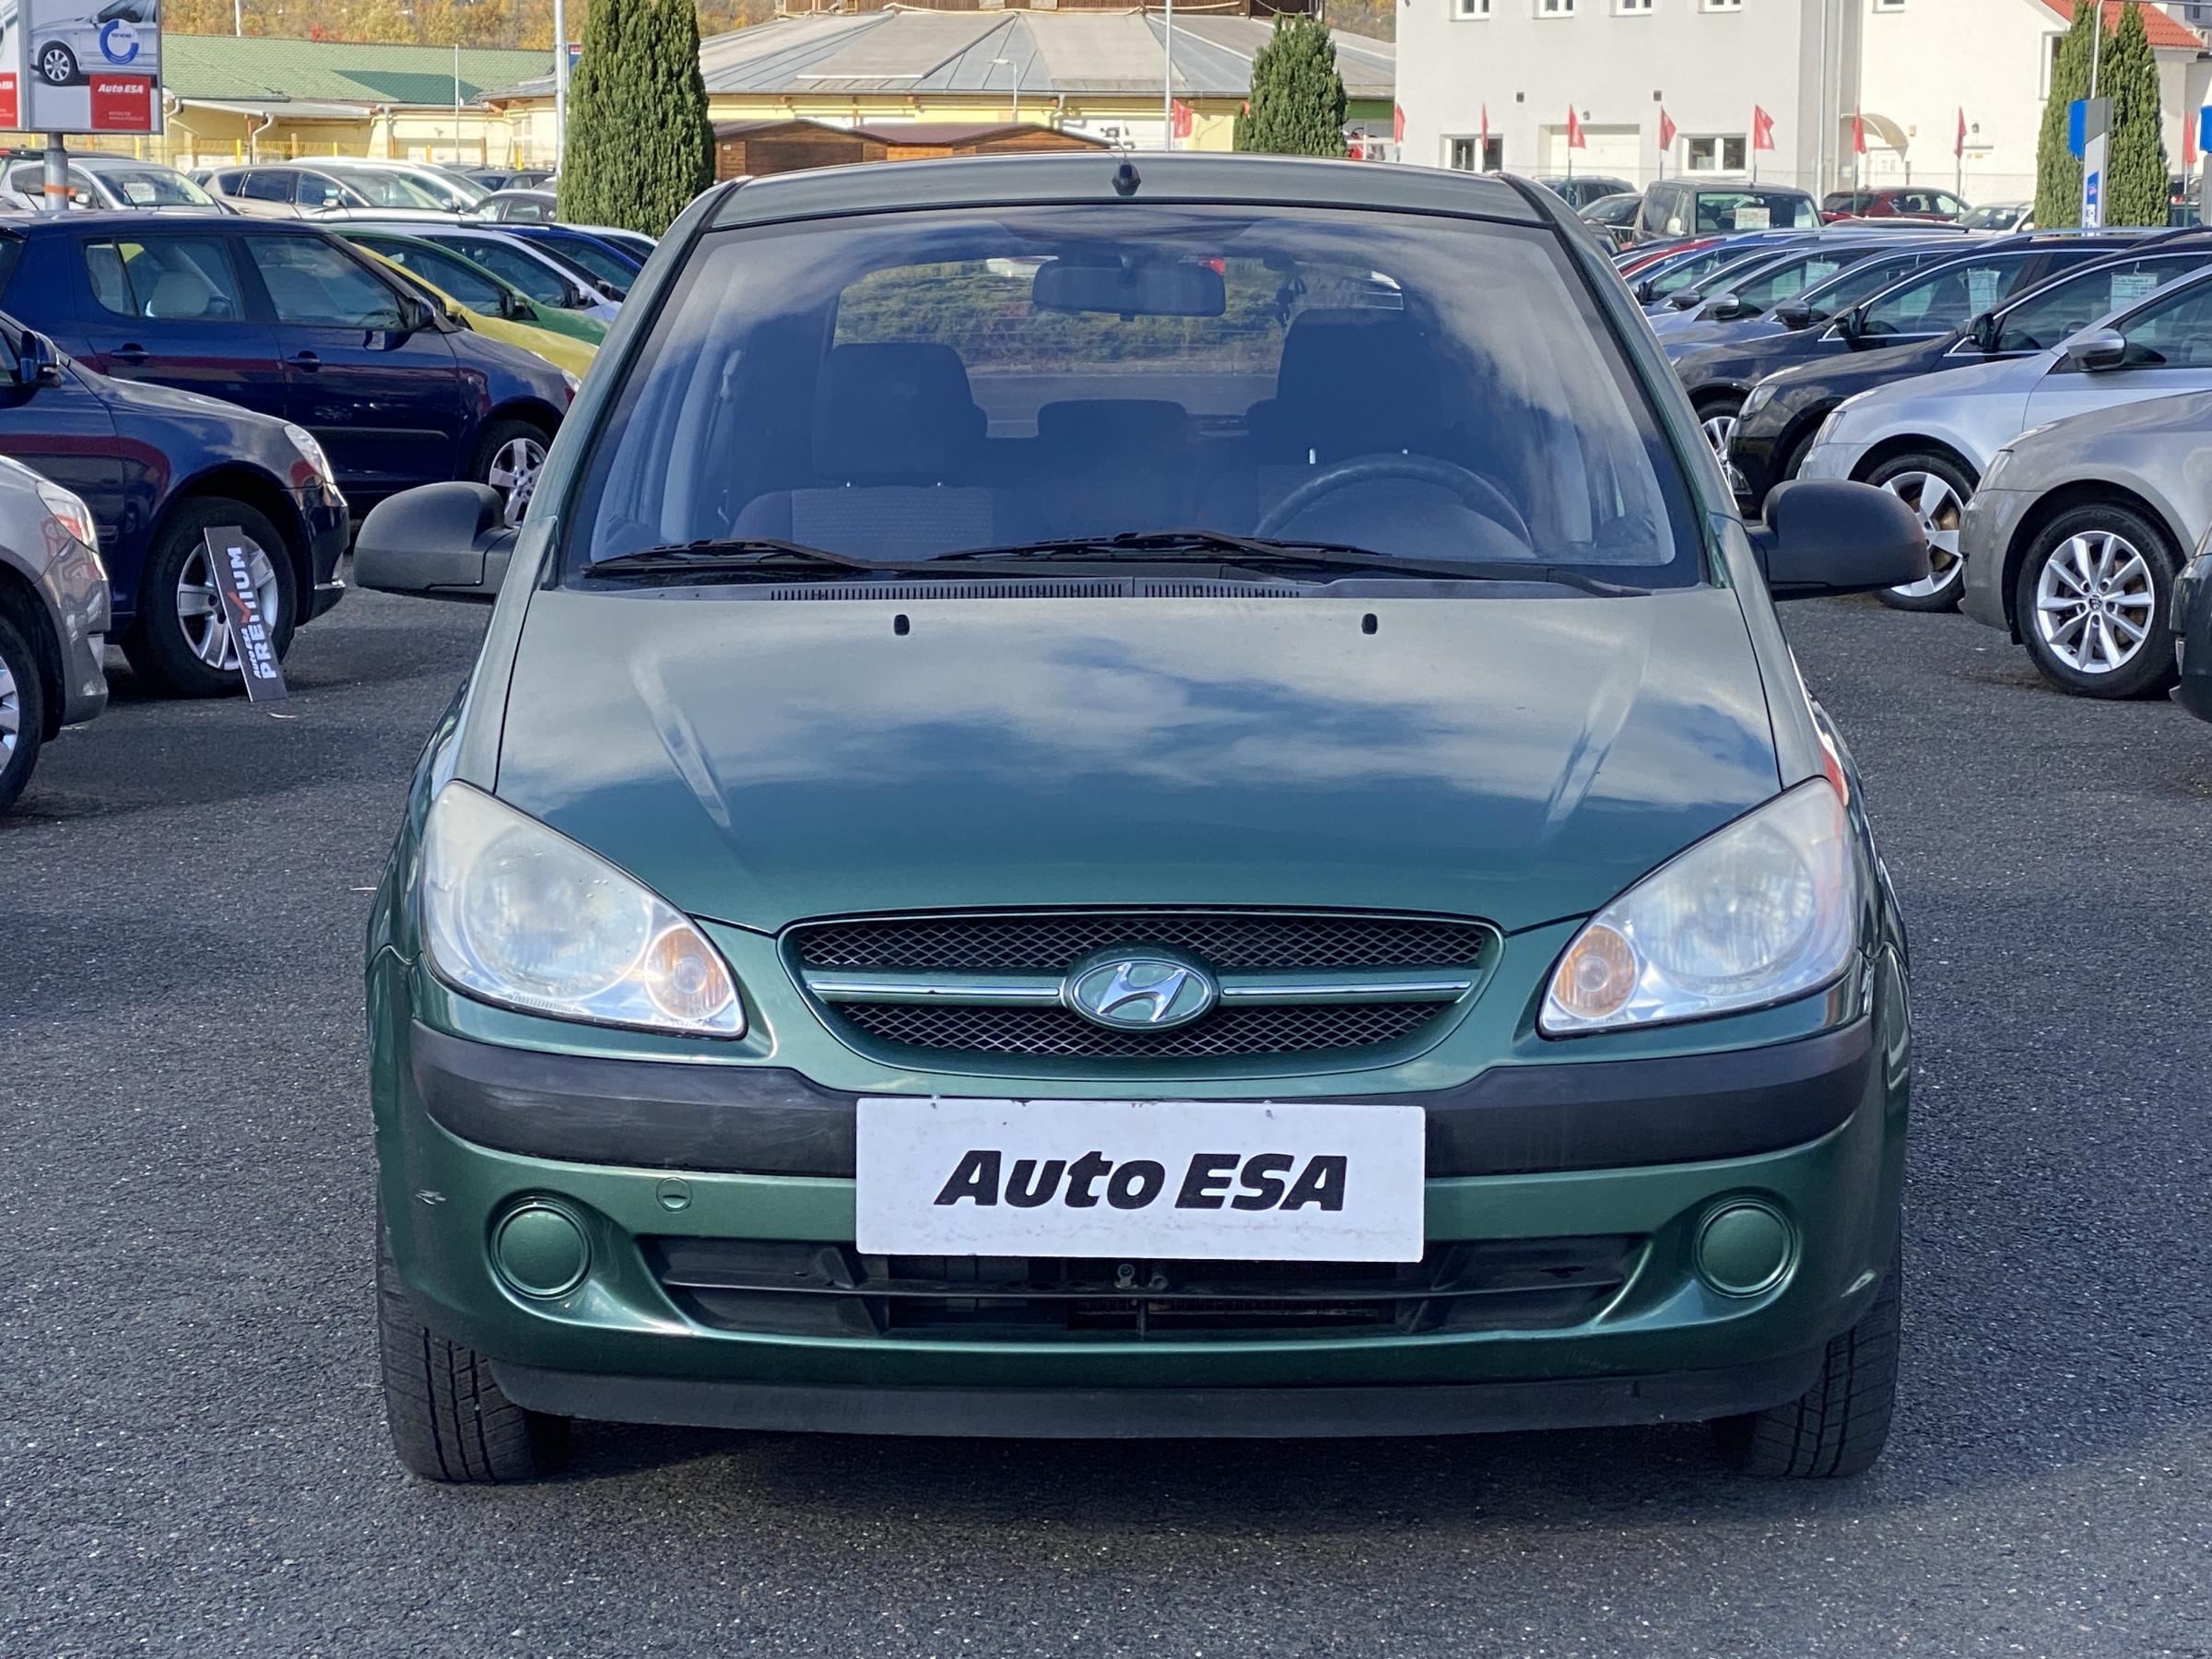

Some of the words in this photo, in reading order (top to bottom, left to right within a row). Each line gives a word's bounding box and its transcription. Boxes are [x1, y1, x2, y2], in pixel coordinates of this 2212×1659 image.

[98, 84, 124, 93] Auto
[123, 85, 144, 93] ESA
[933, 1150, 1166, 1209] Auto
[1174, 1154, 1347, 1211] ESA
